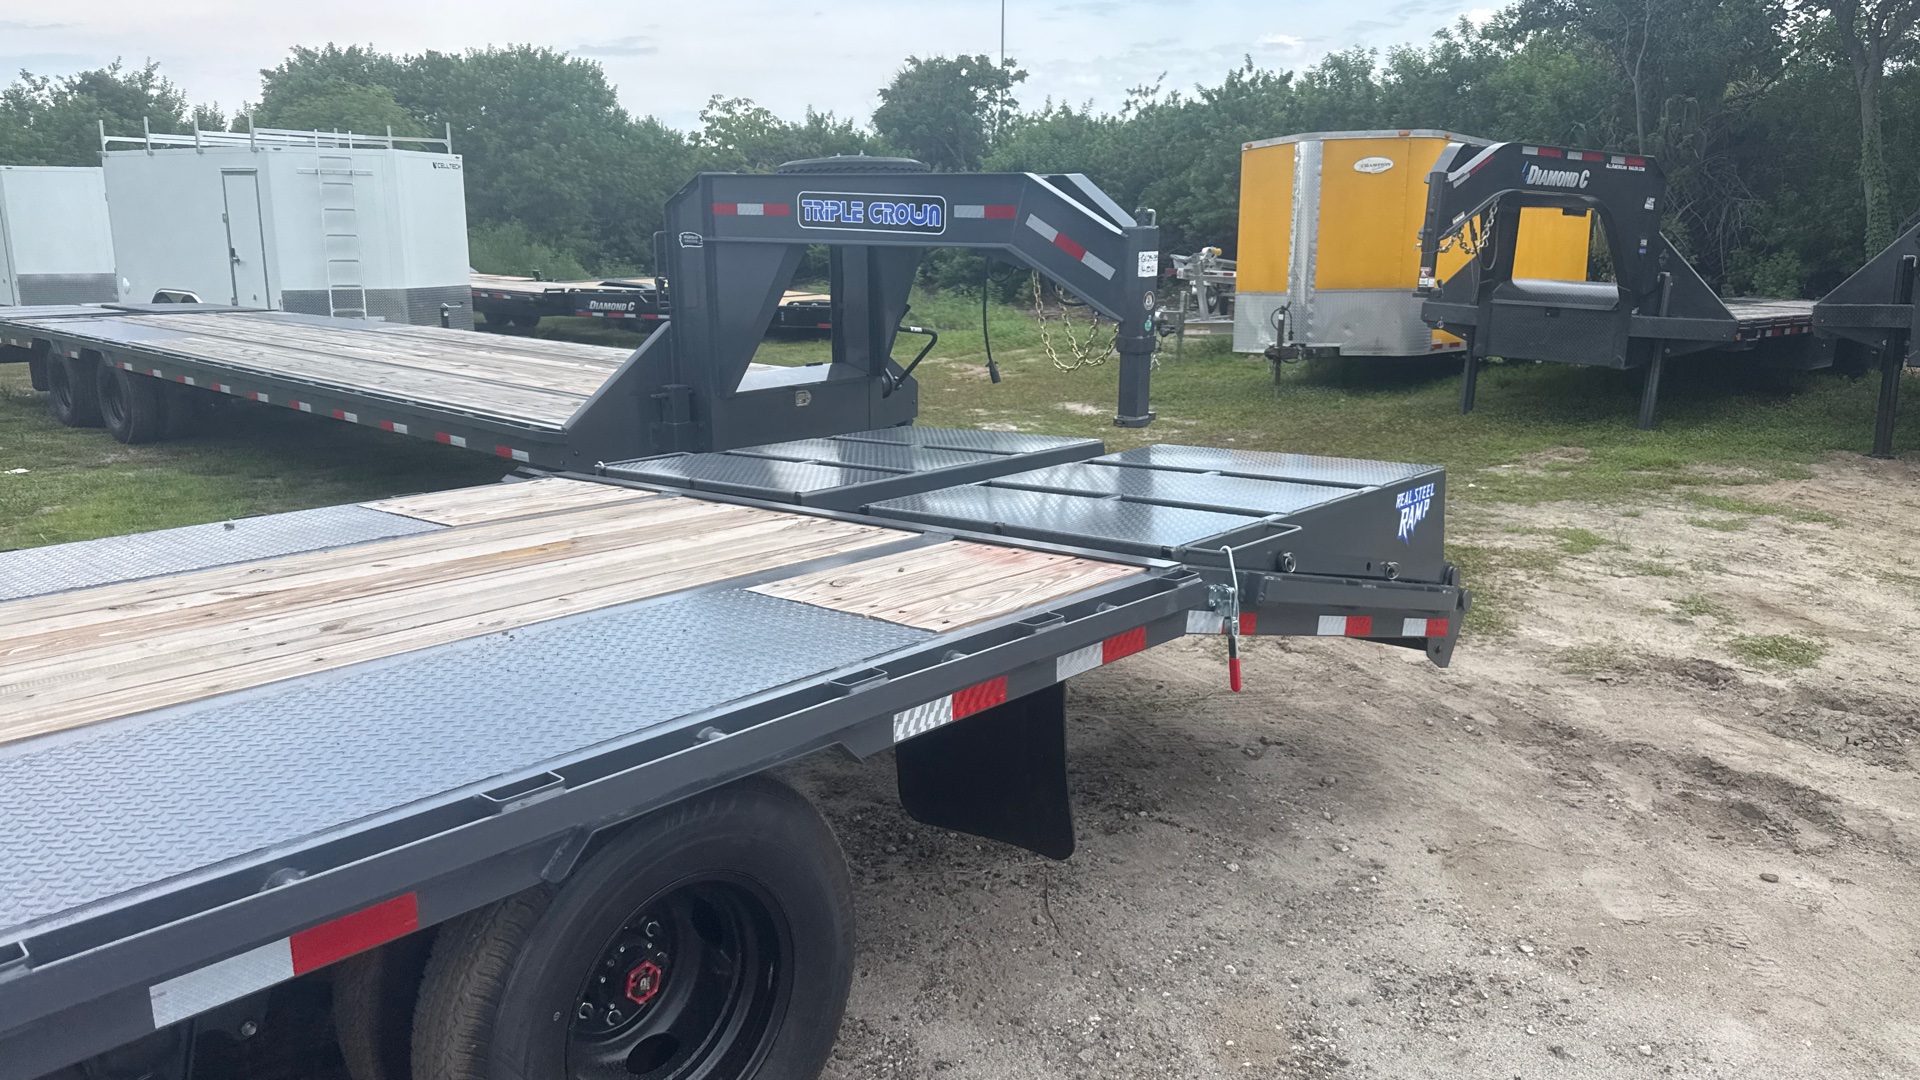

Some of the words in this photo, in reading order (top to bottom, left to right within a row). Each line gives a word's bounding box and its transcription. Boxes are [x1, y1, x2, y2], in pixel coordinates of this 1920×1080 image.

[1526, 165, 1580, 188] DIAMOND
[1579, 169, 1591, 189] C
[801, 199, 864, 223] TRIPLE
[868, 201, 942, 227] CROWN
[589, 300, 628, 311] DIAMOND
[627, 301, 636, 311] C
[1395, 490, 1413, 509] REAL
[1413, 482, 1435, 503] STEEL
[1398, 498, 1431, 541] RAMP
